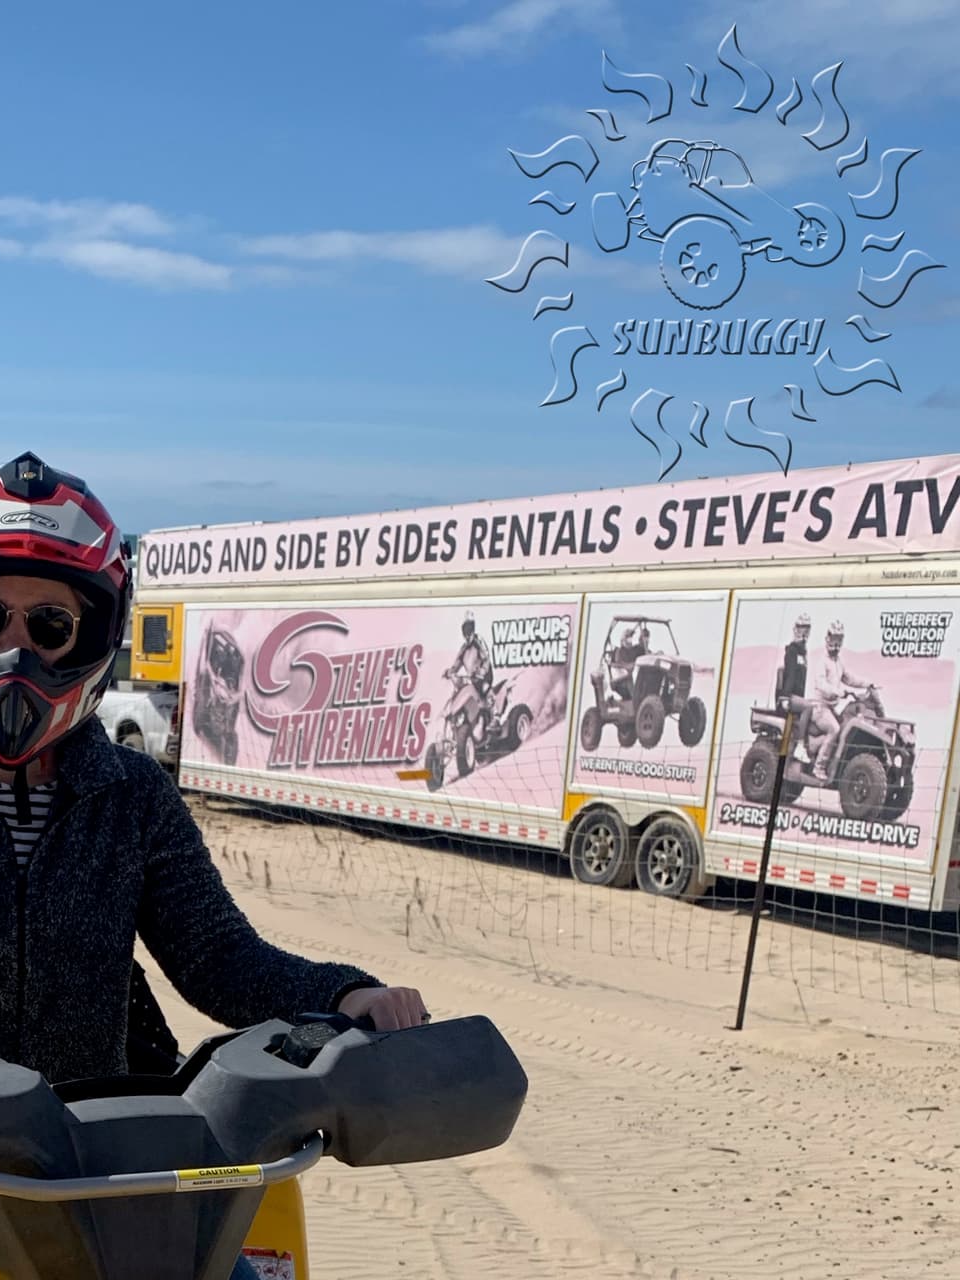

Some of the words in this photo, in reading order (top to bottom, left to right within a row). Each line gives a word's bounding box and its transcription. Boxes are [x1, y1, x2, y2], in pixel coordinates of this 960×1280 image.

[146, 540, 212, 579] QUADS
[219, 536, 267, 573] AND
[275, 531, 327, 571] SIDE
[336, 528, 369, 567] BY
[376, 520, 458, 565] SIDES
[468, 505, 621, 560] RENTALS
[654, 487, 835, 550] STEVE'S
[848, 475, 960, 539] ATV
[492, 616, 571, 644] WALK-UPS
[881, 612, 904, 627] THE
[905, 612, 953, 627] PERFECT
[883, 628, 918, 641] QUAD
[920, 628, 945, 641] FOR
[493, 640, 568, 667] WELCOME
[268, 710, 323, 768] ATV
[315, 702, 432, 767] RENTALS
[581, 757, 594, 771] WE
[595, 758, 617, 774] RENT
[618, 759, 634, 775] THE
[635, 762, 664, 777] GOOD
[721, 804, 790, 831] 2-PERSN
[802, 815, 869, 842] 4-WHEEL
[871, 822, 919, 848] DRIVE
[199, 1167, 240, 1177] CAUTION
